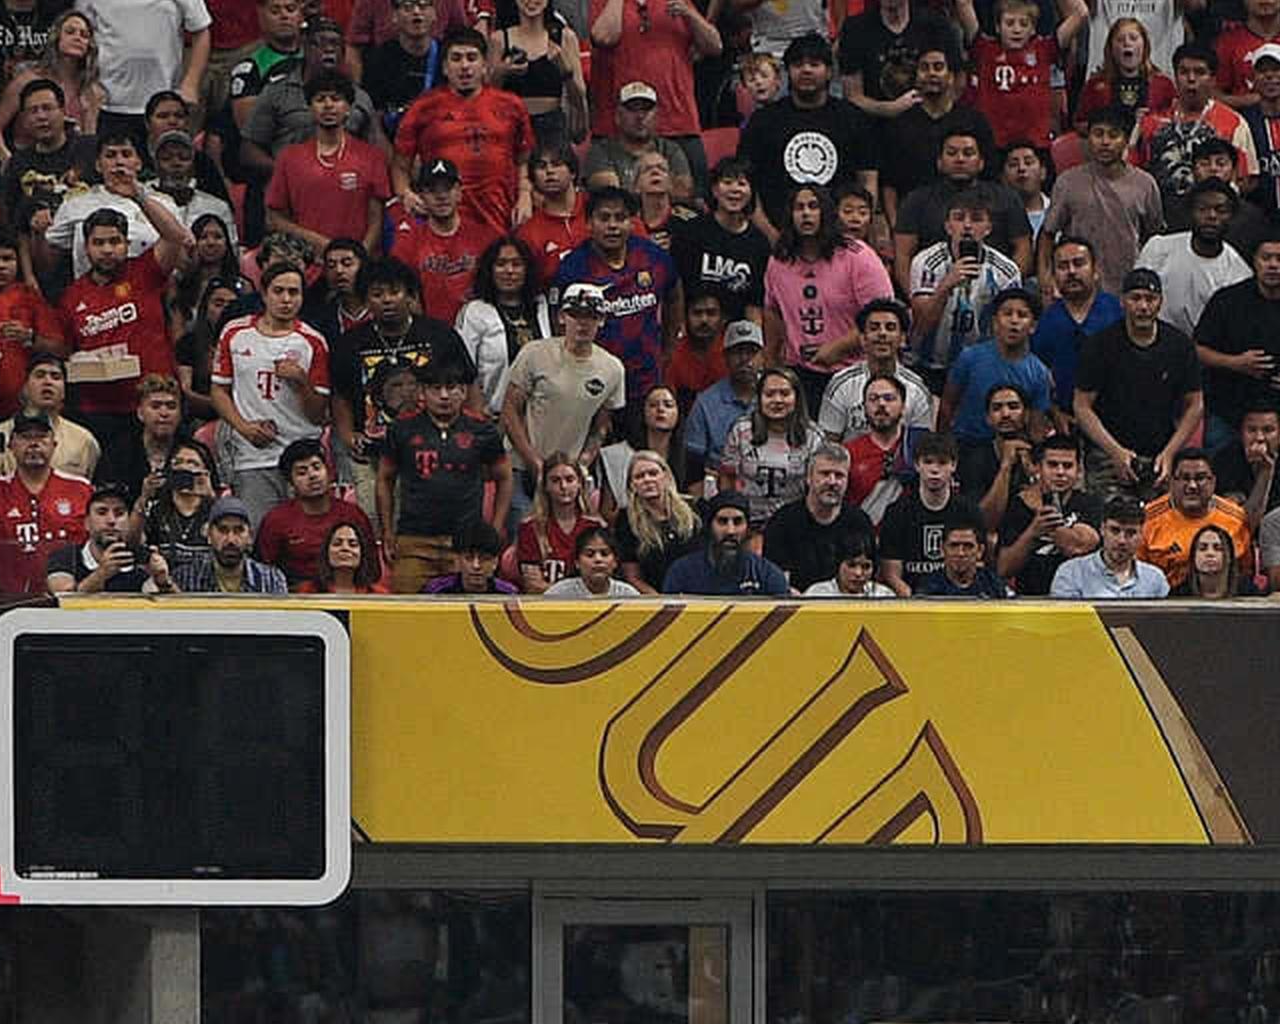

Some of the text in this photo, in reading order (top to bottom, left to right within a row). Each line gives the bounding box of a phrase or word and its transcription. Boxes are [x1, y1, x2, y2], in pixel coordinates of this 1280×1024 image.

[995, 65, 1015, 91] T
[255, 370, 279, 401] T
[415, 450, 439, 480] T
[756, 464, 787, 498] T
[16, 522, 40, 552] T
[544, 559, 566, 586] T
